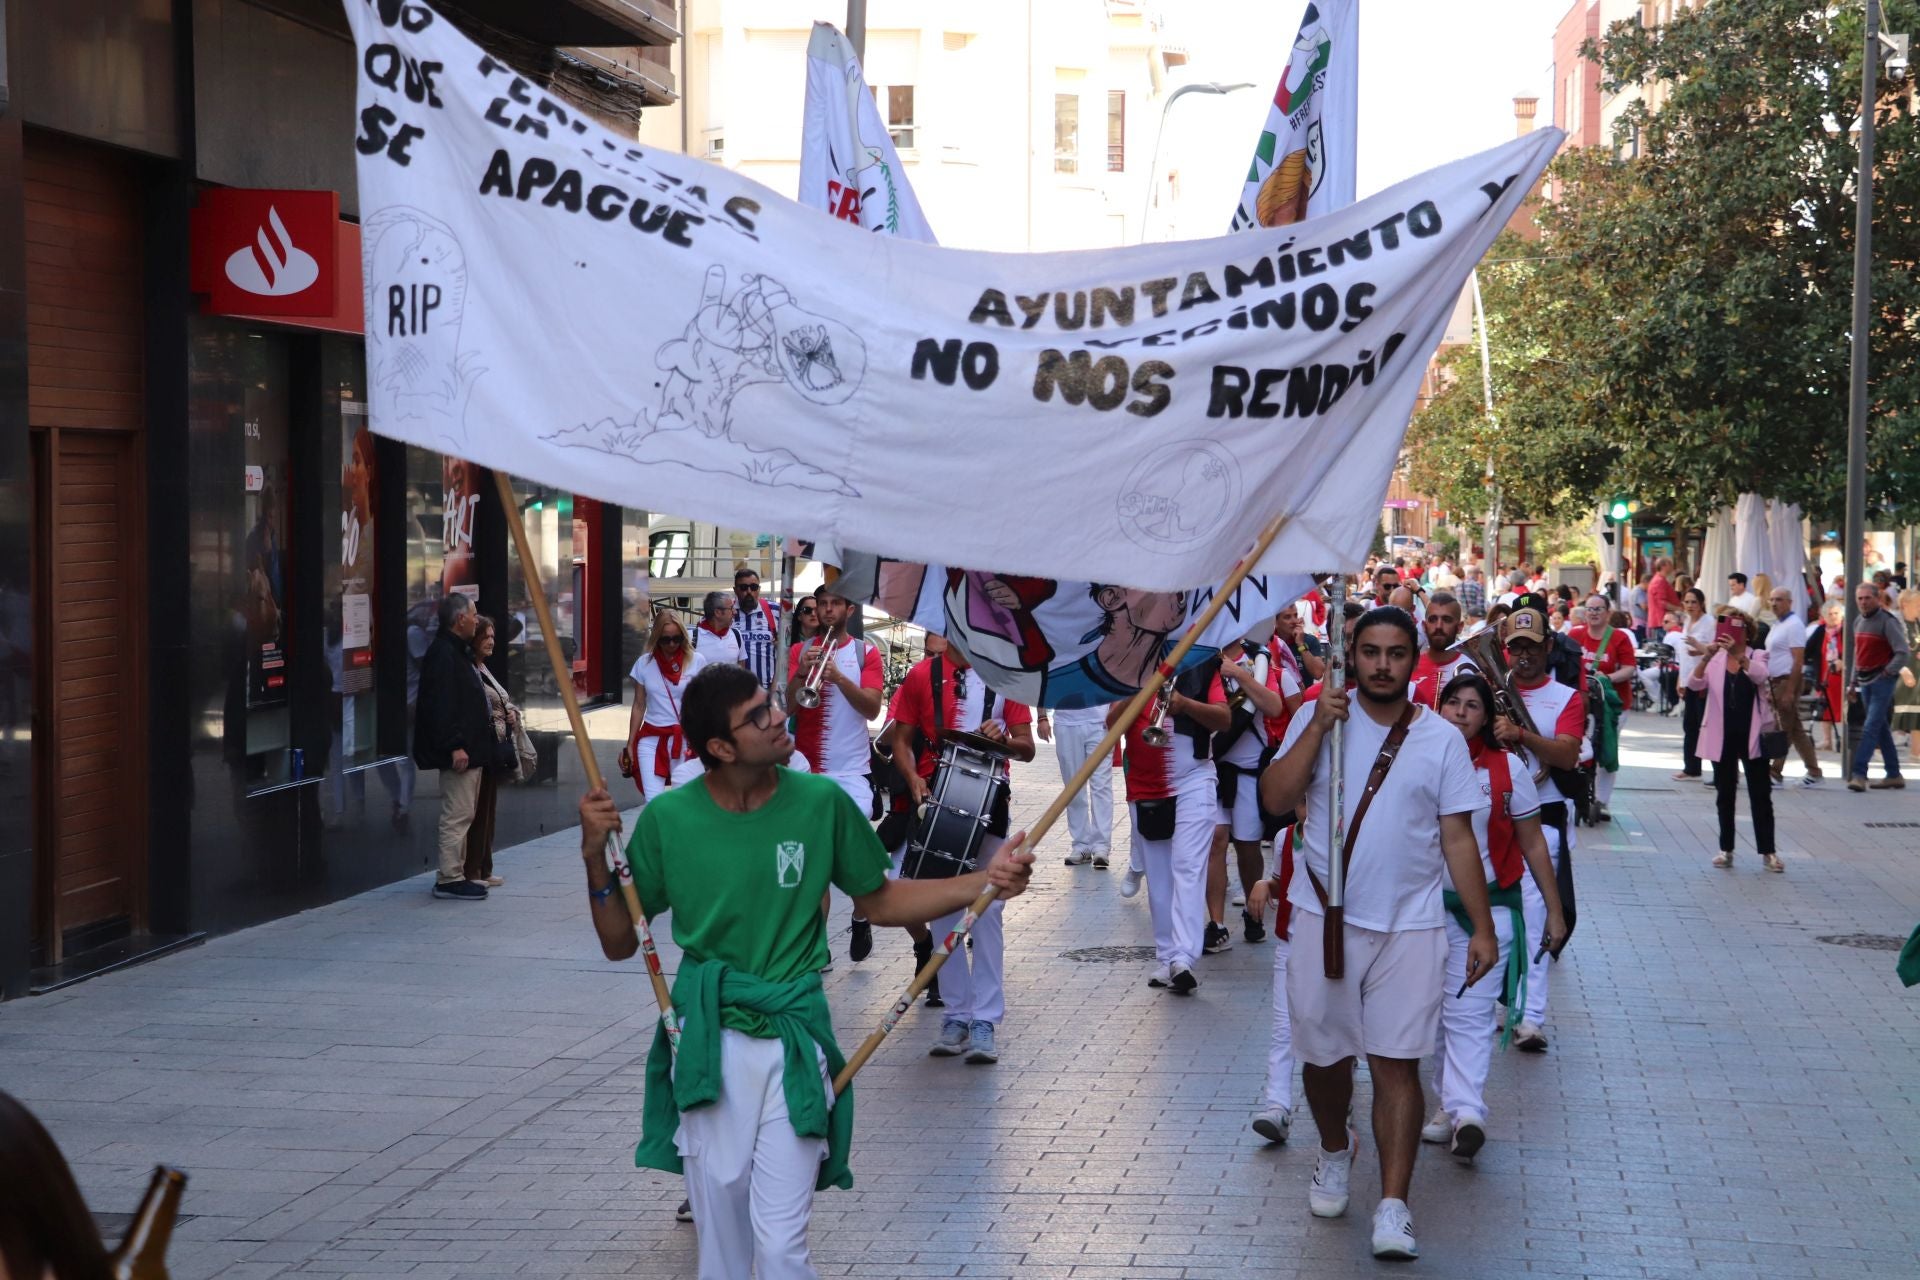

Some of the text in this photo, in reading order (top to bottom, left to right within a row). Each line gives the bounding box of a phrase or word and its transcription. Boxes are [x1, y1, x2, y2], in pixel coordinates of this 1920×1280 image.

[365, 43, 444, 109] QUE
[356, 103, 425, 167] SE
[479, 149, 705, 248] APAGUE
[388, 283, 442, 338] RIP
[910, 338, 999, 391] NO
[1032, 348, 1176, 418] NOS
[443, 487, 480, 548] ART
